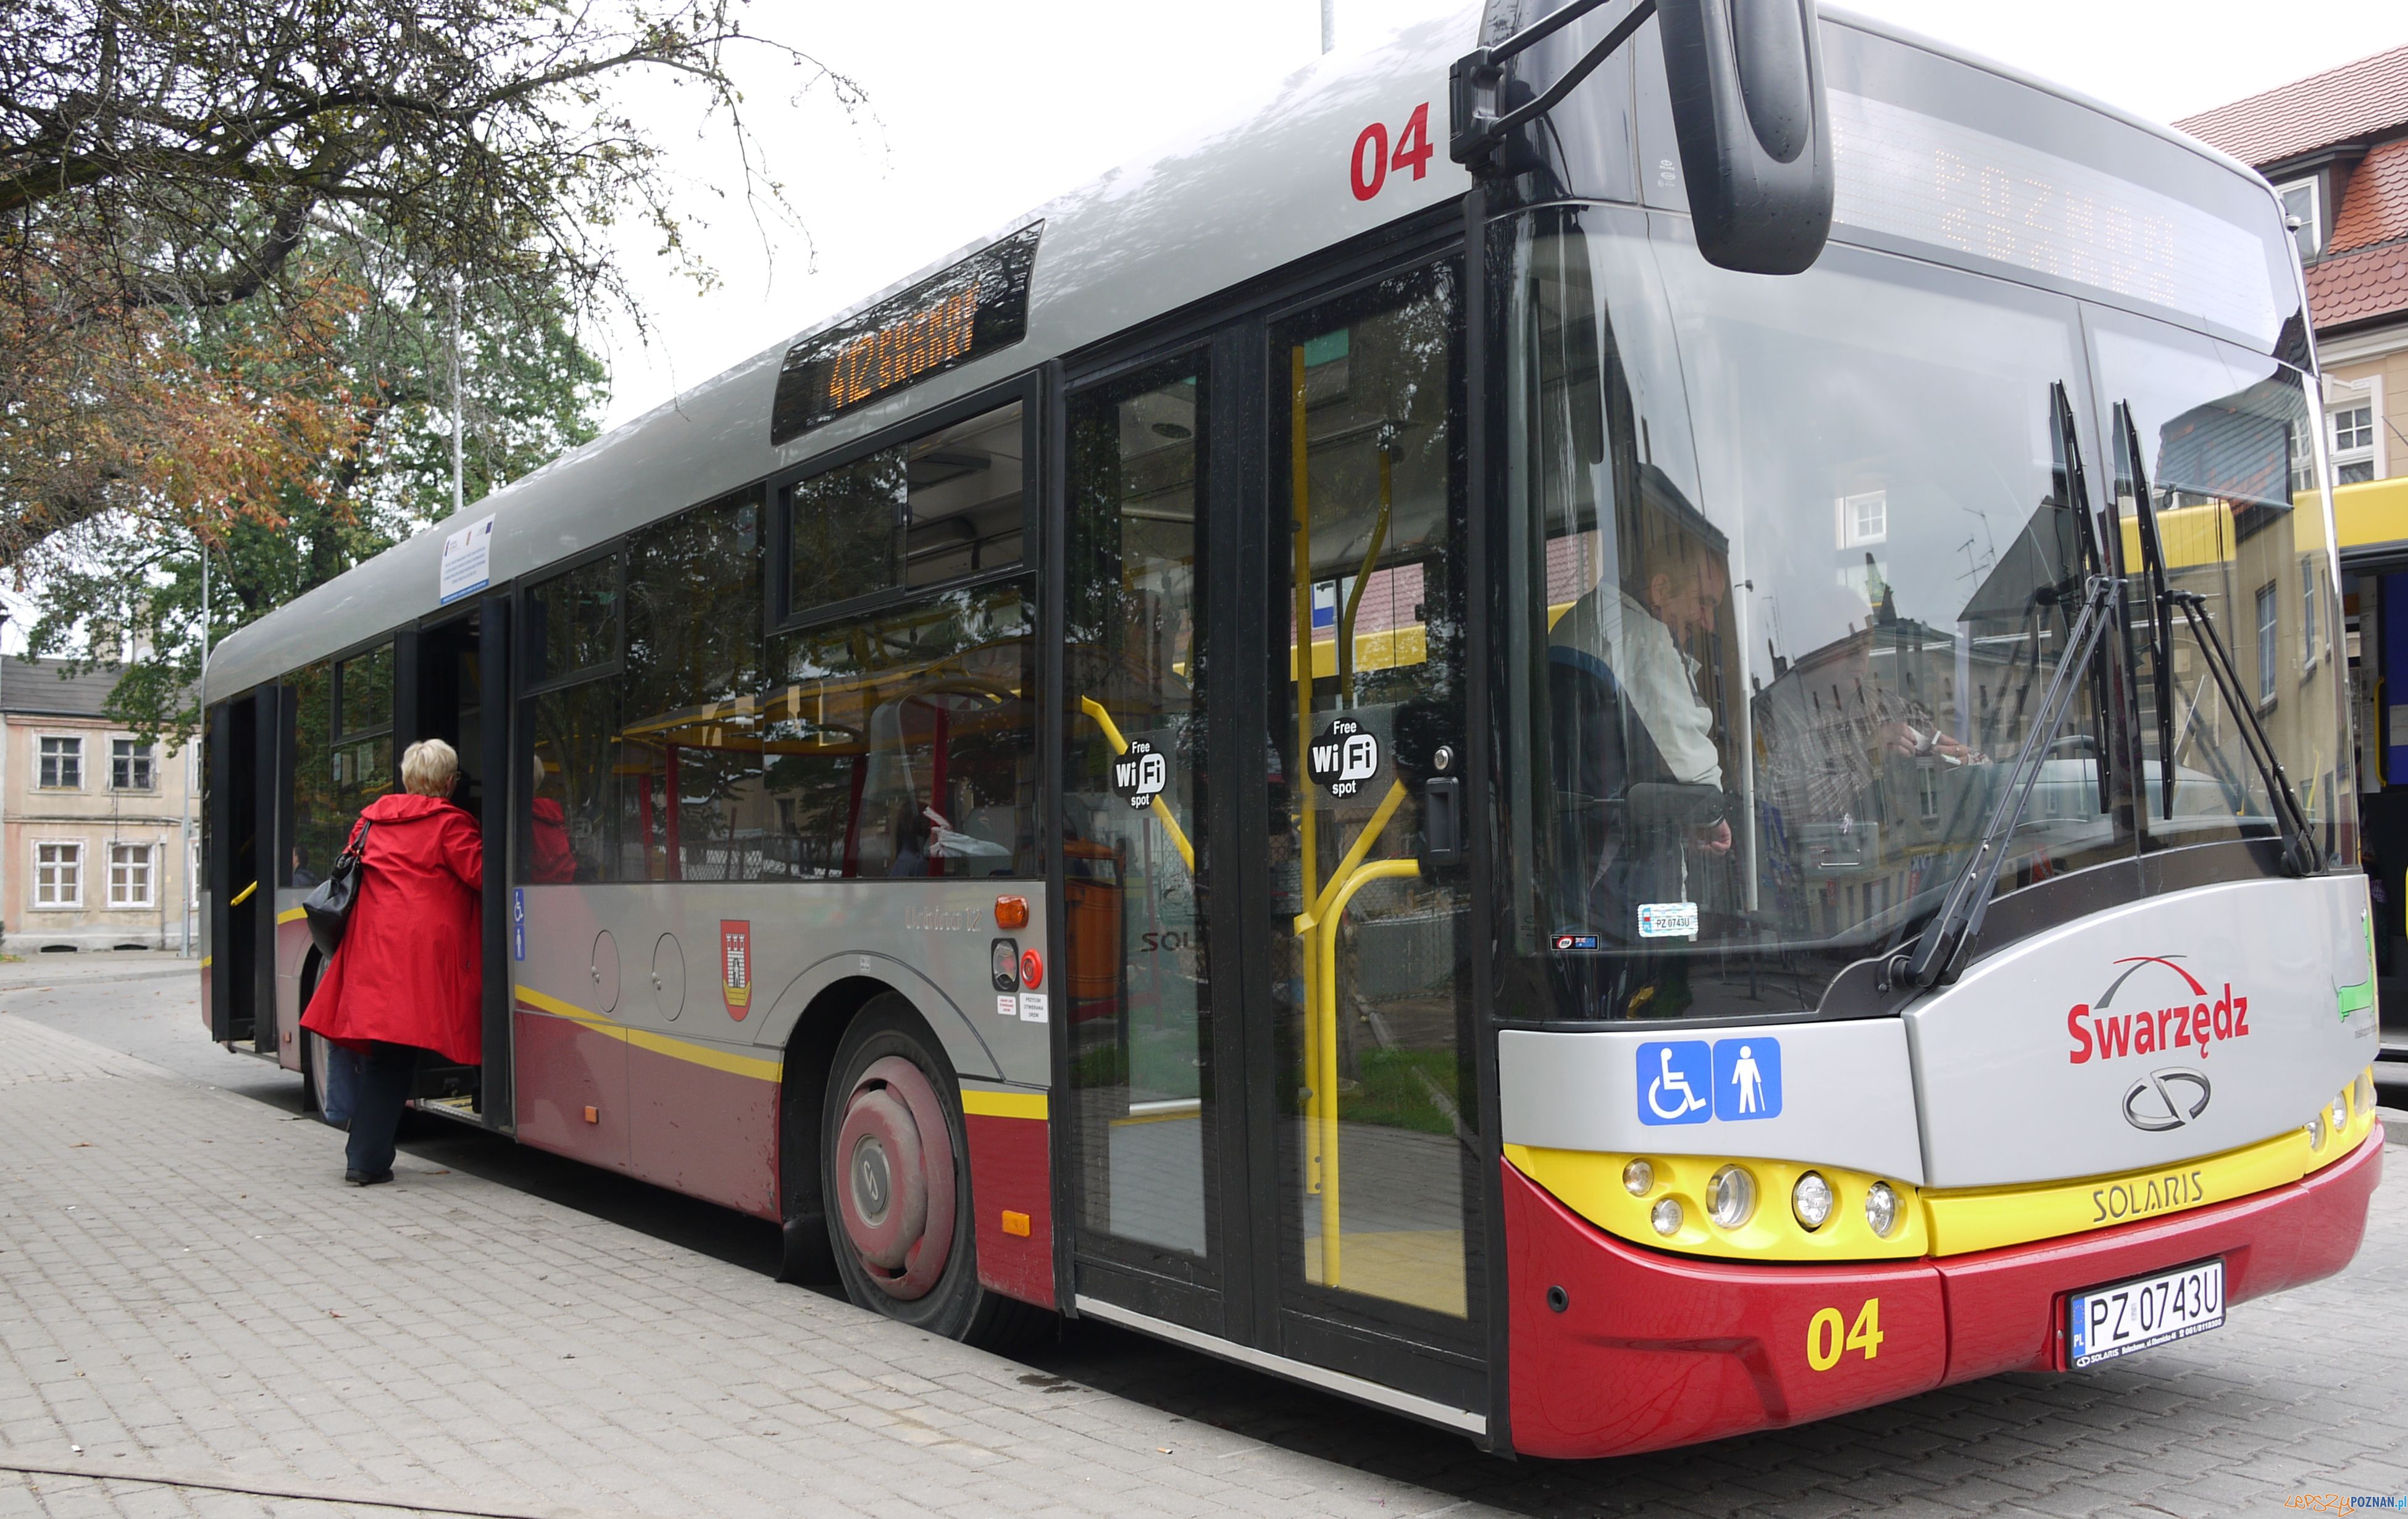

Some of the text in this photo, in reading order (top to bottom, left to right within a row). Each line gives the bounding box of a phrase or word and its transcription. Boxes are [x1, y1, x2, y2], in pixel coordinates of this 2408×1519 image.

[1350, 101, 1434, 201] 04
[829, 334, 874, 409] 412
[1333, 721, 1357, 734] Free
[1132, 741, 1150, 754] Free
[1313, 740, 1371, 772] WiFi
[1116, 760, 1162, 787] WiFi
[1131, 793, 1150, 808] spot
[1332, 780, 1357, 797] spot
[905, 905, 982, 932] Urbino 12
[1657, 919, 1666, 928] PZ
[1668, 918, 1690, 927] 0743U
[2067, 983, 2250, 1064] Swarzędz
[2093, 1171, 2204, 1223] SOLARIS
[2091, 1269, 2218, 1347] PZ 0743U
[1807, 1297, 1884, 1371] 04
[2074, 1333, 2084, 1347] PL
[2091, 1349, 2119, 1363] SOLARIS
